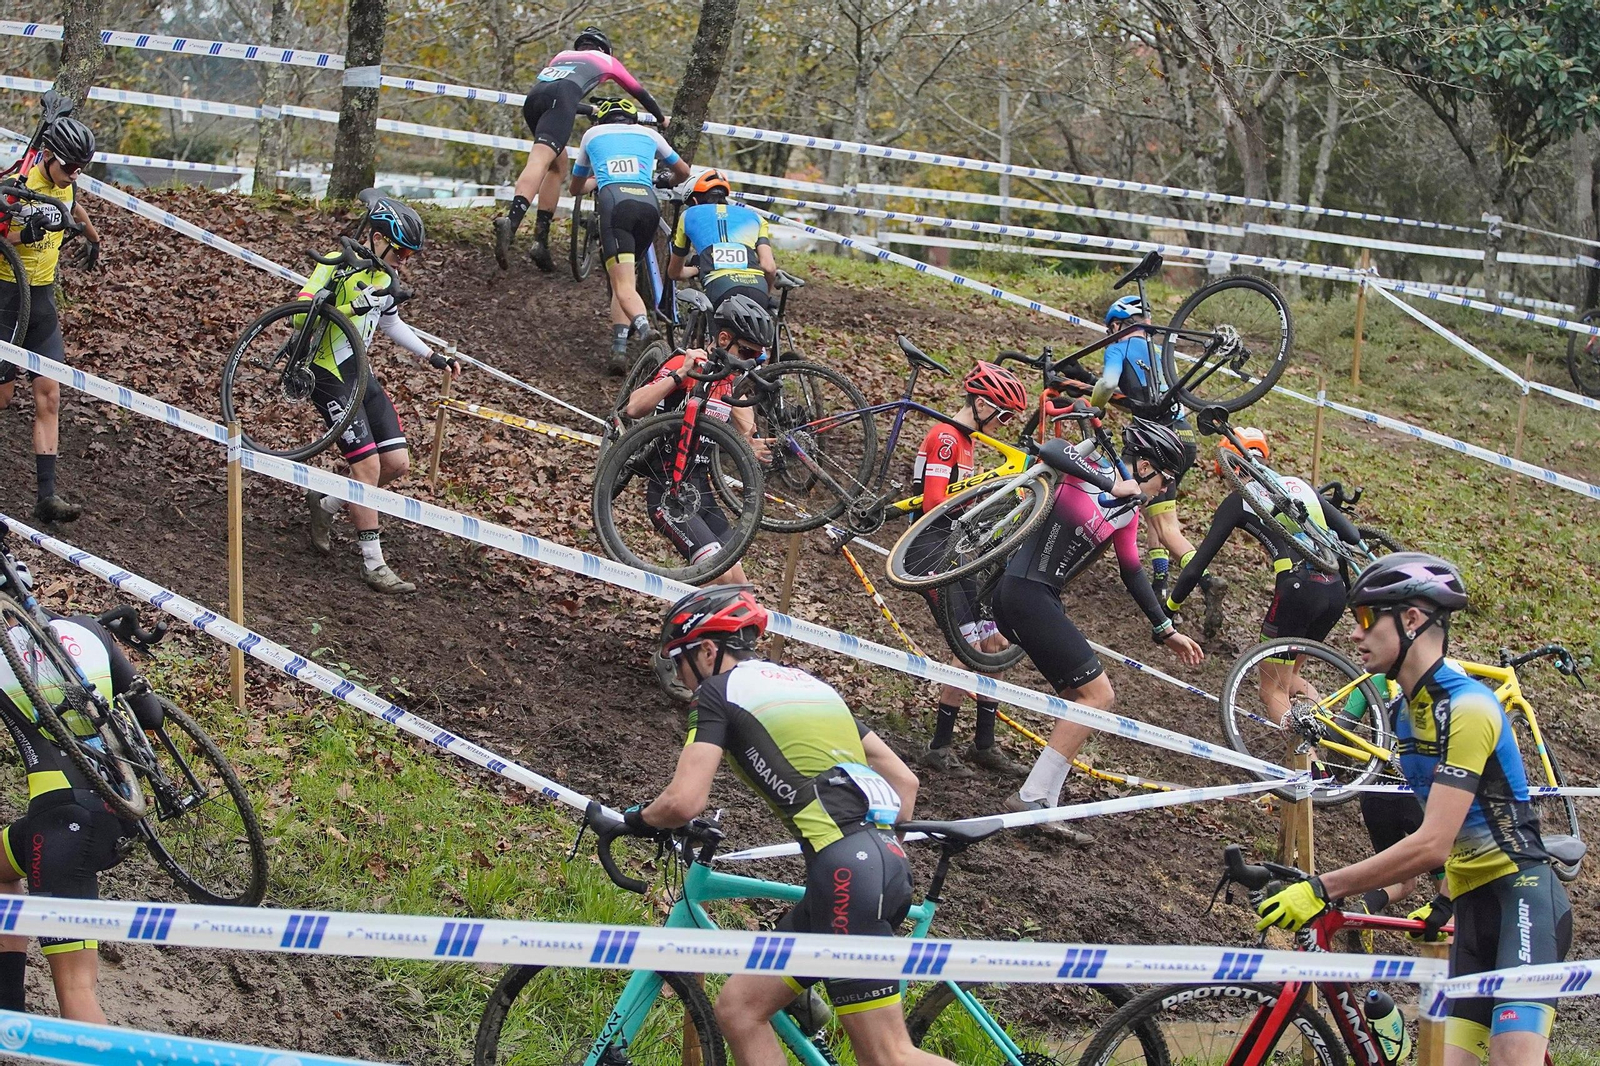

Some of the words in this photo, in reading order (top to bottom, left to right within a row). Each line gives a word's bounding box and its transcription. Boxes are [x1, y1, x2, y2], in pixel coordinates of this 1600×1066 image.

[543, 67, 567, 78] 210
[610, 160, 635, 173] 201
[715, 249, 746, 263] 250
[1077, 455, 1099, 475] MARIN
[31, 833, 45, 888] CORUXO
[1337, 991, 1378, 1066] MMR
